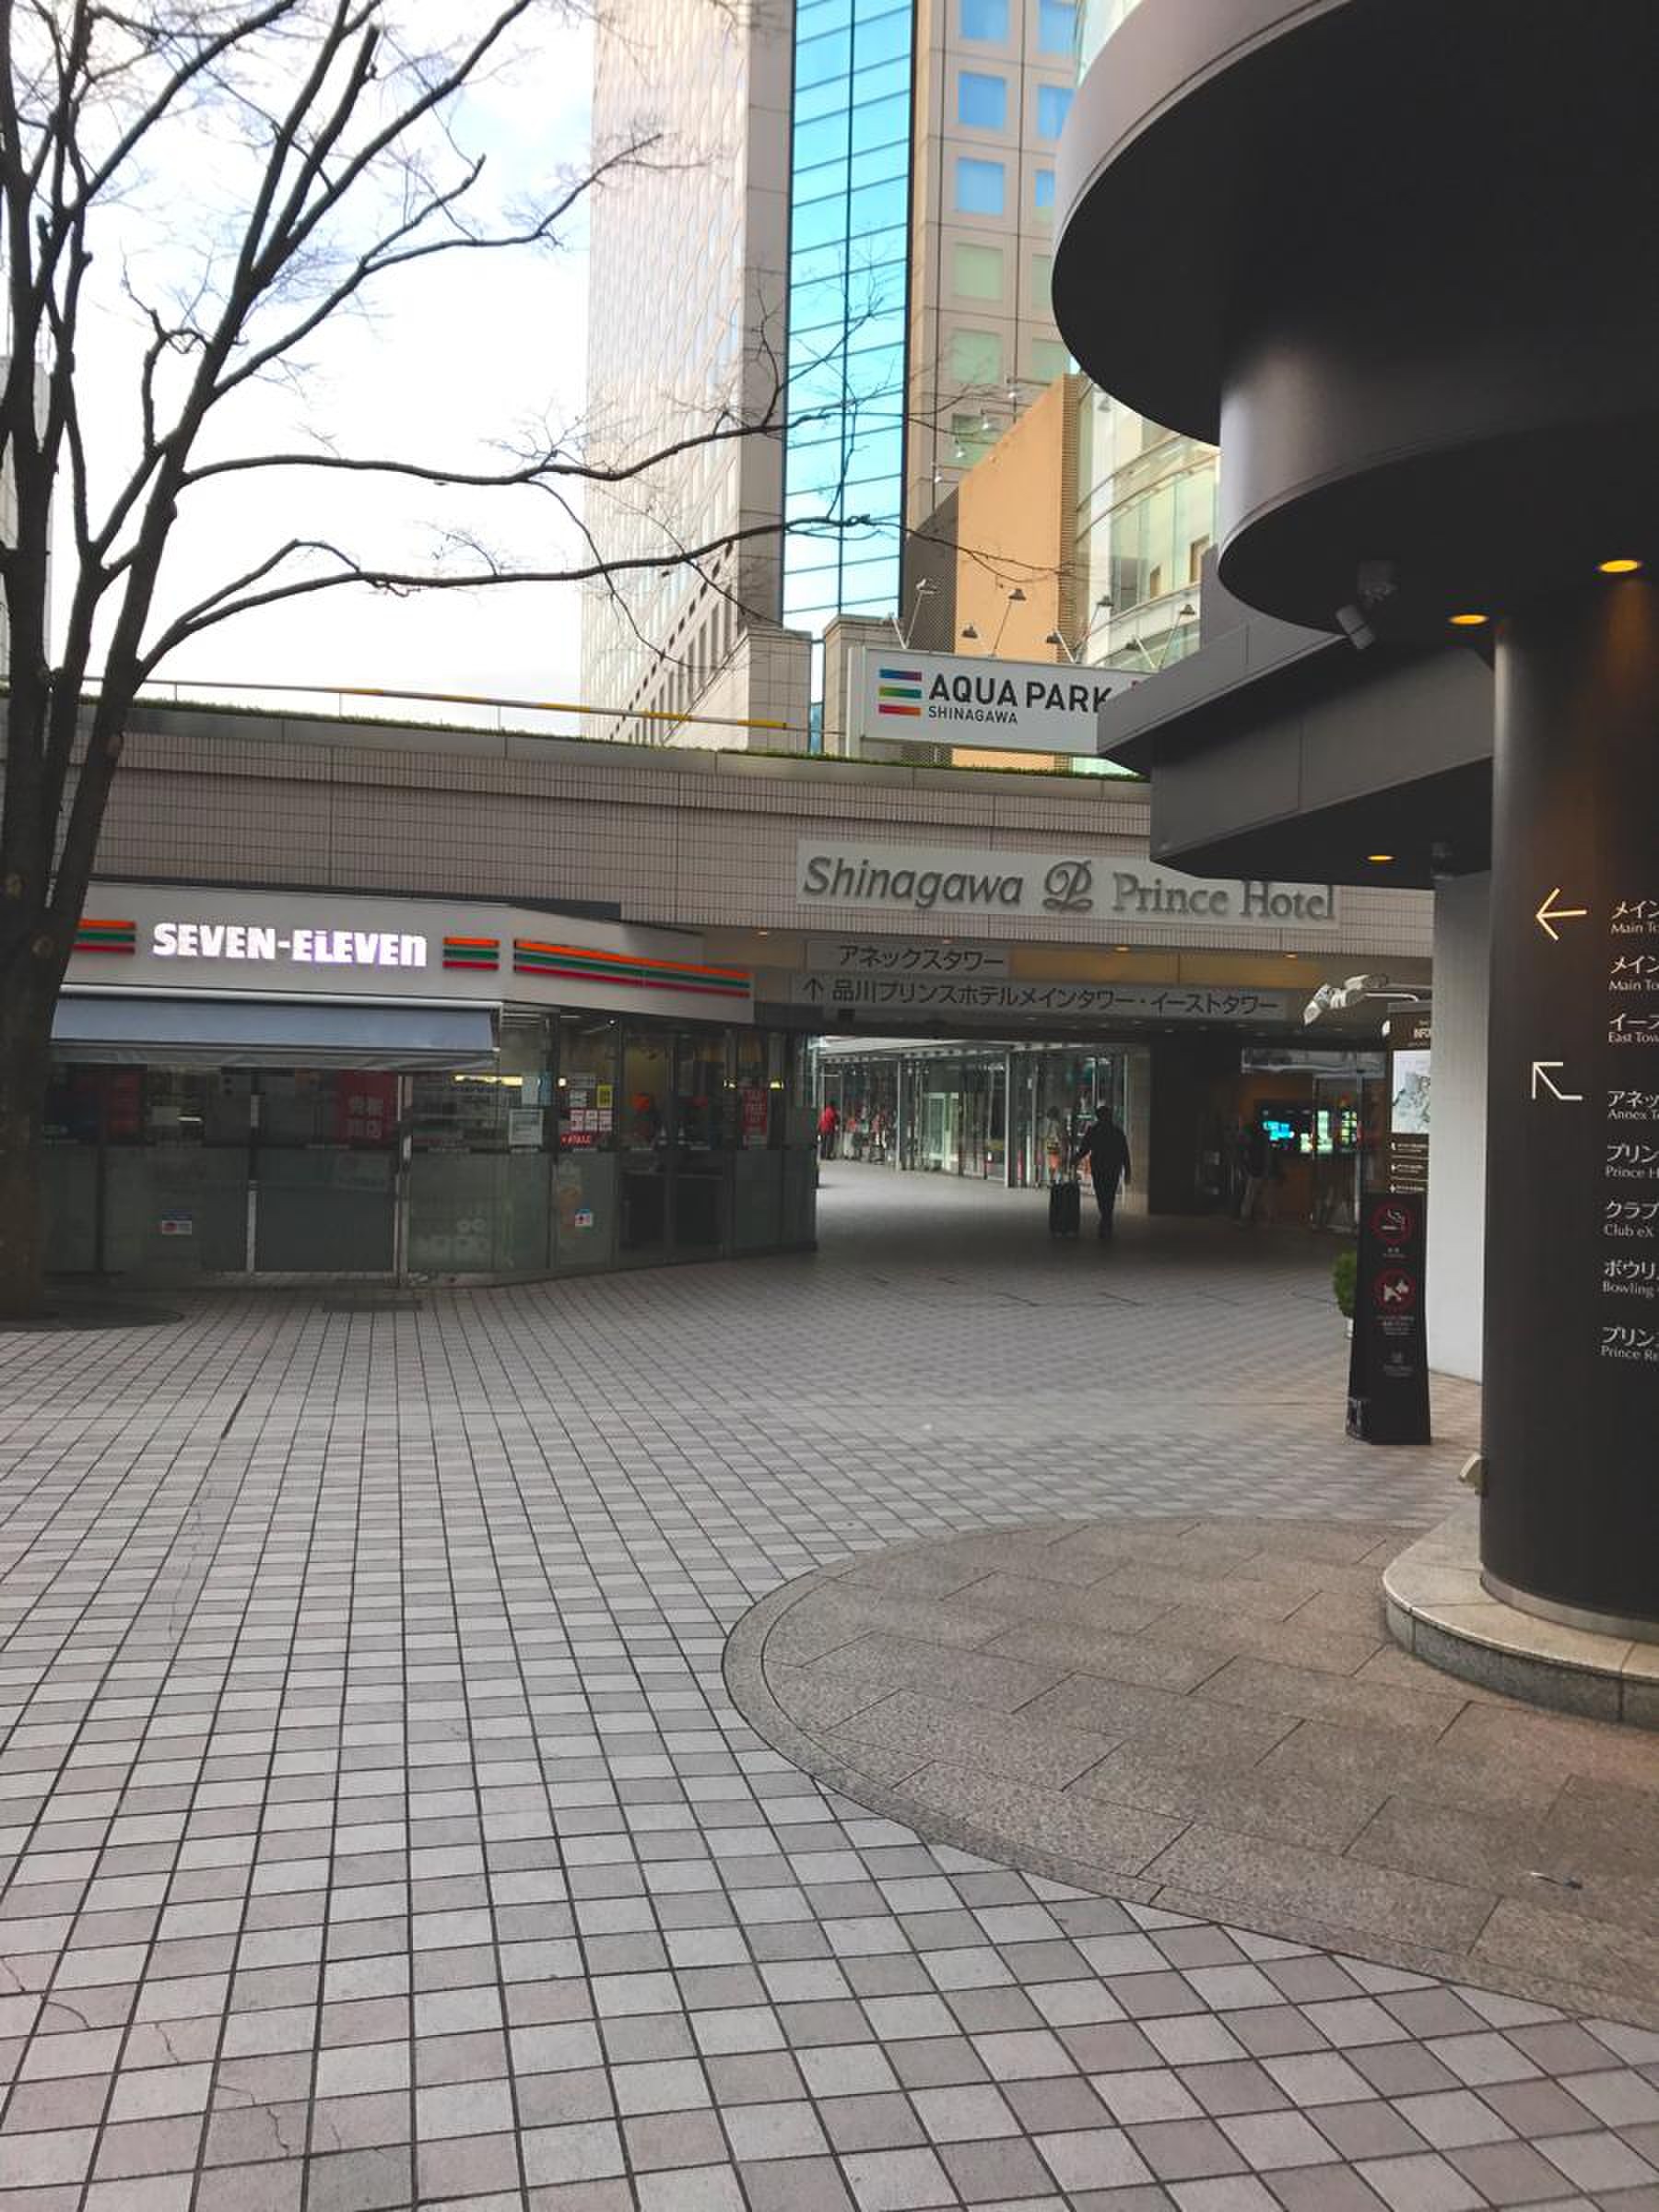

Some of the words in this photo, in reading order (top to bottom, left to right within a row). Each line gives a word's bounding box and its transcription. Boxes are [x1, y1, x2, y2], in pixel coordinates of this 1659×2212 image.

[928, 673, 1018, 708] AQUA
[1025, 681, 1112, 713] PARK
[927, 705, 1018, 725] SHINAGAWA
[803, 855, 1024, 909] Shinagawa
[1112, 872, 1229, 917] Prince
[1239, 878, 1335, 921] Hotel
[1610, 923, 1643, 935] Main
[838, 944, 1004, 973] アネックスタワー
[1608, 980, 1641, 991] Main
[1608, 1032, 1632, 1042] East
[1605, 1165, 1645, 1179] Prince
[1604, 1223, 1633, 1237] Club
[1604, 1260, 1659, 1280] ボウリ
